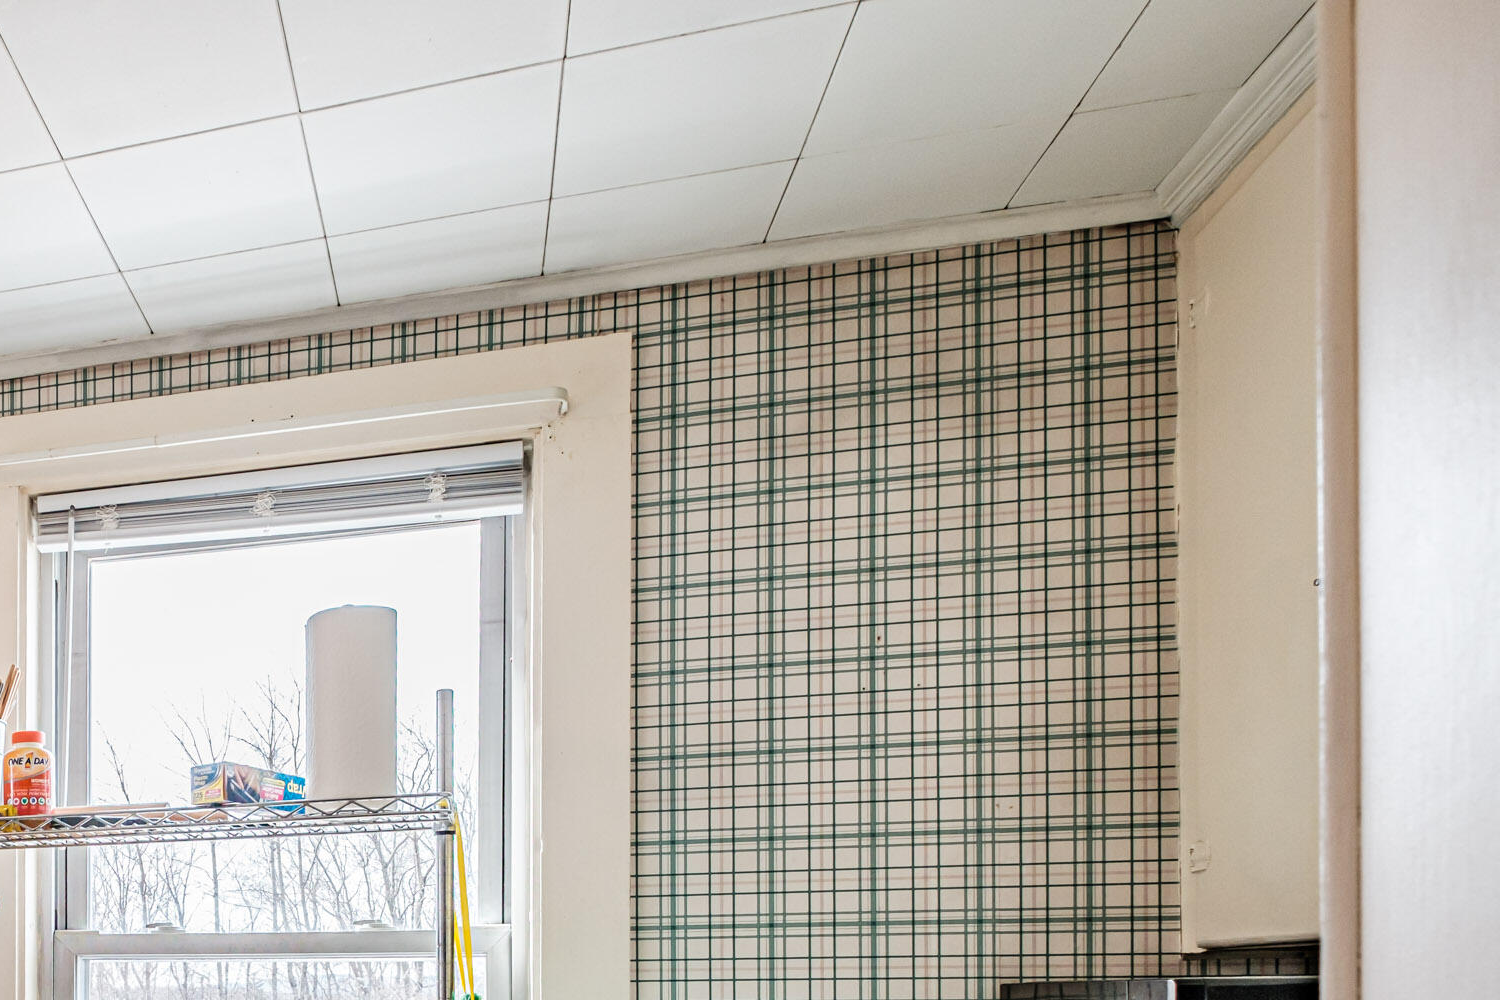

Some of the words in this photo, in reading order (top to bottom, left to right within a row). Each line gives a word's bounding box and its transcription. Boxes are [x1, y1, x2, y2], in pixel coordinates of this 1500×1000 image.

[8, 758, 24, 766] ONE
[34, 757, 49, 765] DAY
[287, 779, 306, 799] rap
